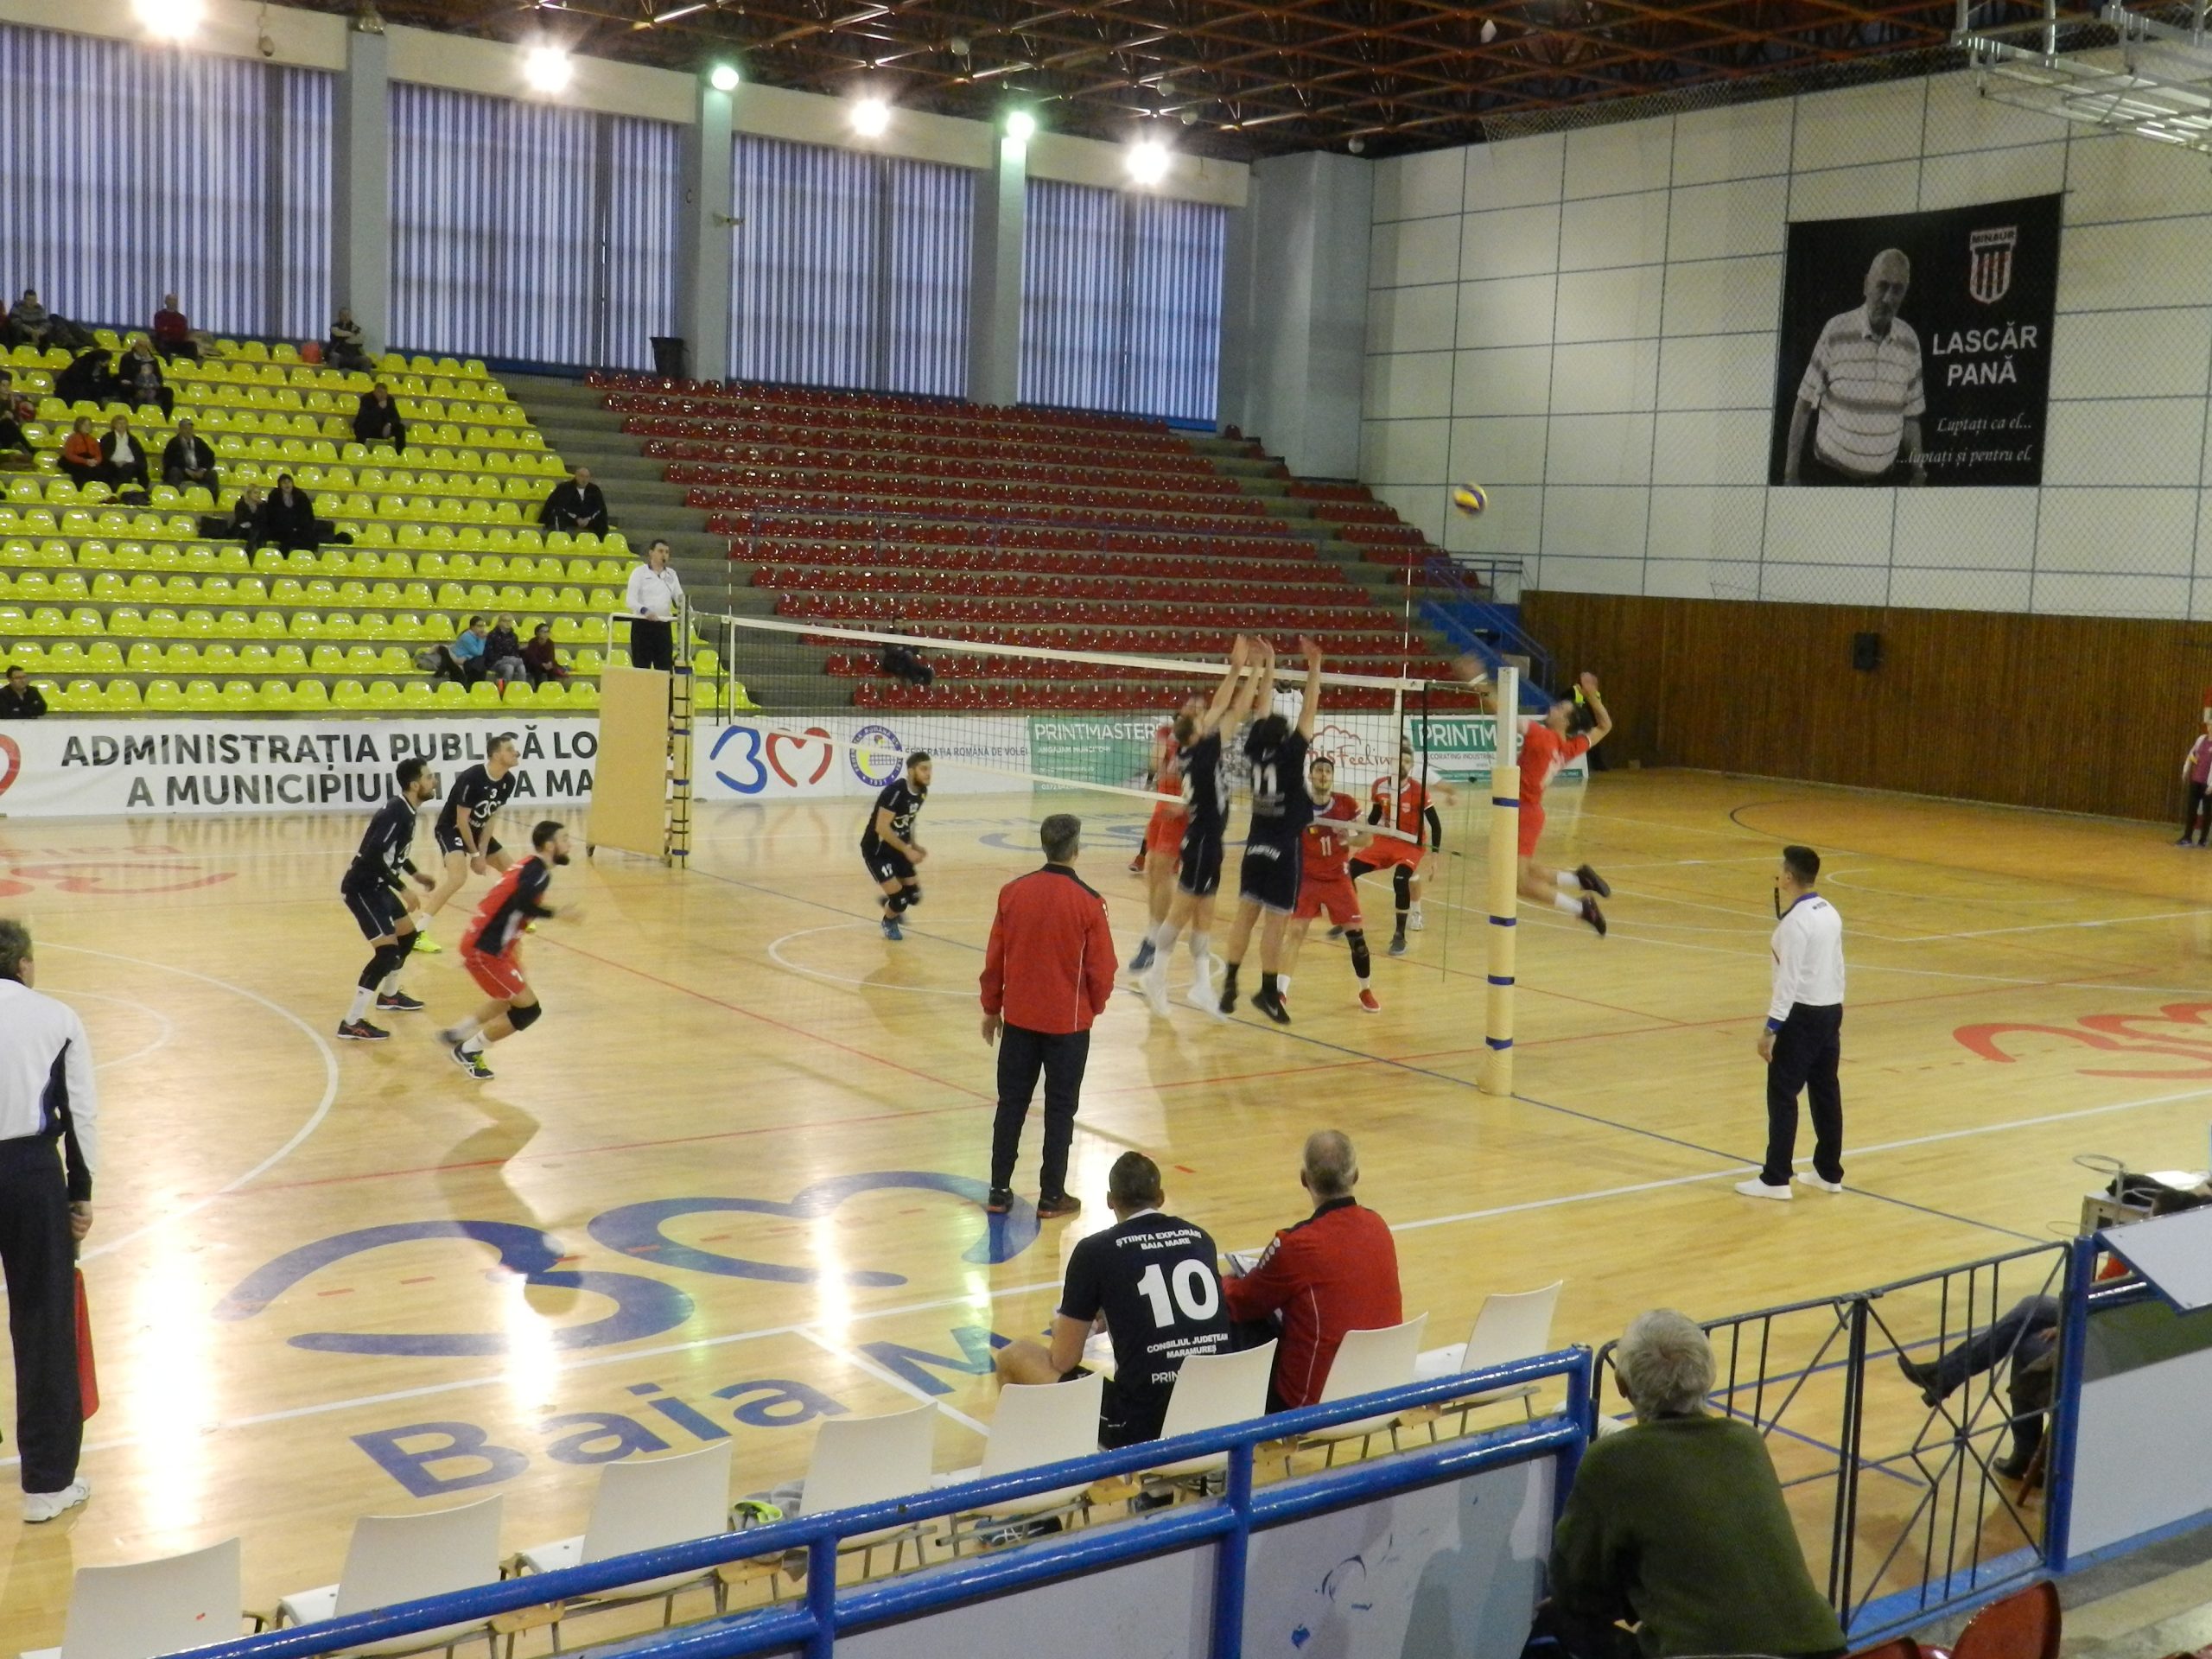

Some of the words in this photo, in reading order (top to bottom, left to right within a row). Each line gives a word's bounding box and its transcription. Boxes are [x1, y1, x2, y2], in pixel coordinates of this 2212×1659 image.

[1971, 231, 2016, 244] MINAUR
[1932, 321, 2037, 355] LASCĂR
[1947, 354, 2017, 386] PANĂ
[1990, 418, 2005, 430] ca
[1969, 450, 2013, 467] pentru
[61, 734, 380, 770] ADMINISTRAȚIA
[389, 725, 545, 762] PUBLĂ
[991, 747, 1002, 757] DE
[1254, 763, 1277, 797] 11
[127, 777, 155, 807] A
[489, 788, 499, 800] 3
[1319, 836, 1332, 856] 11
[1141, 1241, 1165, 1250] BAIA
[1164, 1237, 1192, 1246] MARE
[1136, 1258, 1219, 1329] 10
[1147, 1338, 1191, 1354] CONSILIUL
[1166, 1344, 1217, 1359] MARAMUREȘ
[348, 1378, 849, 1499] Baia
